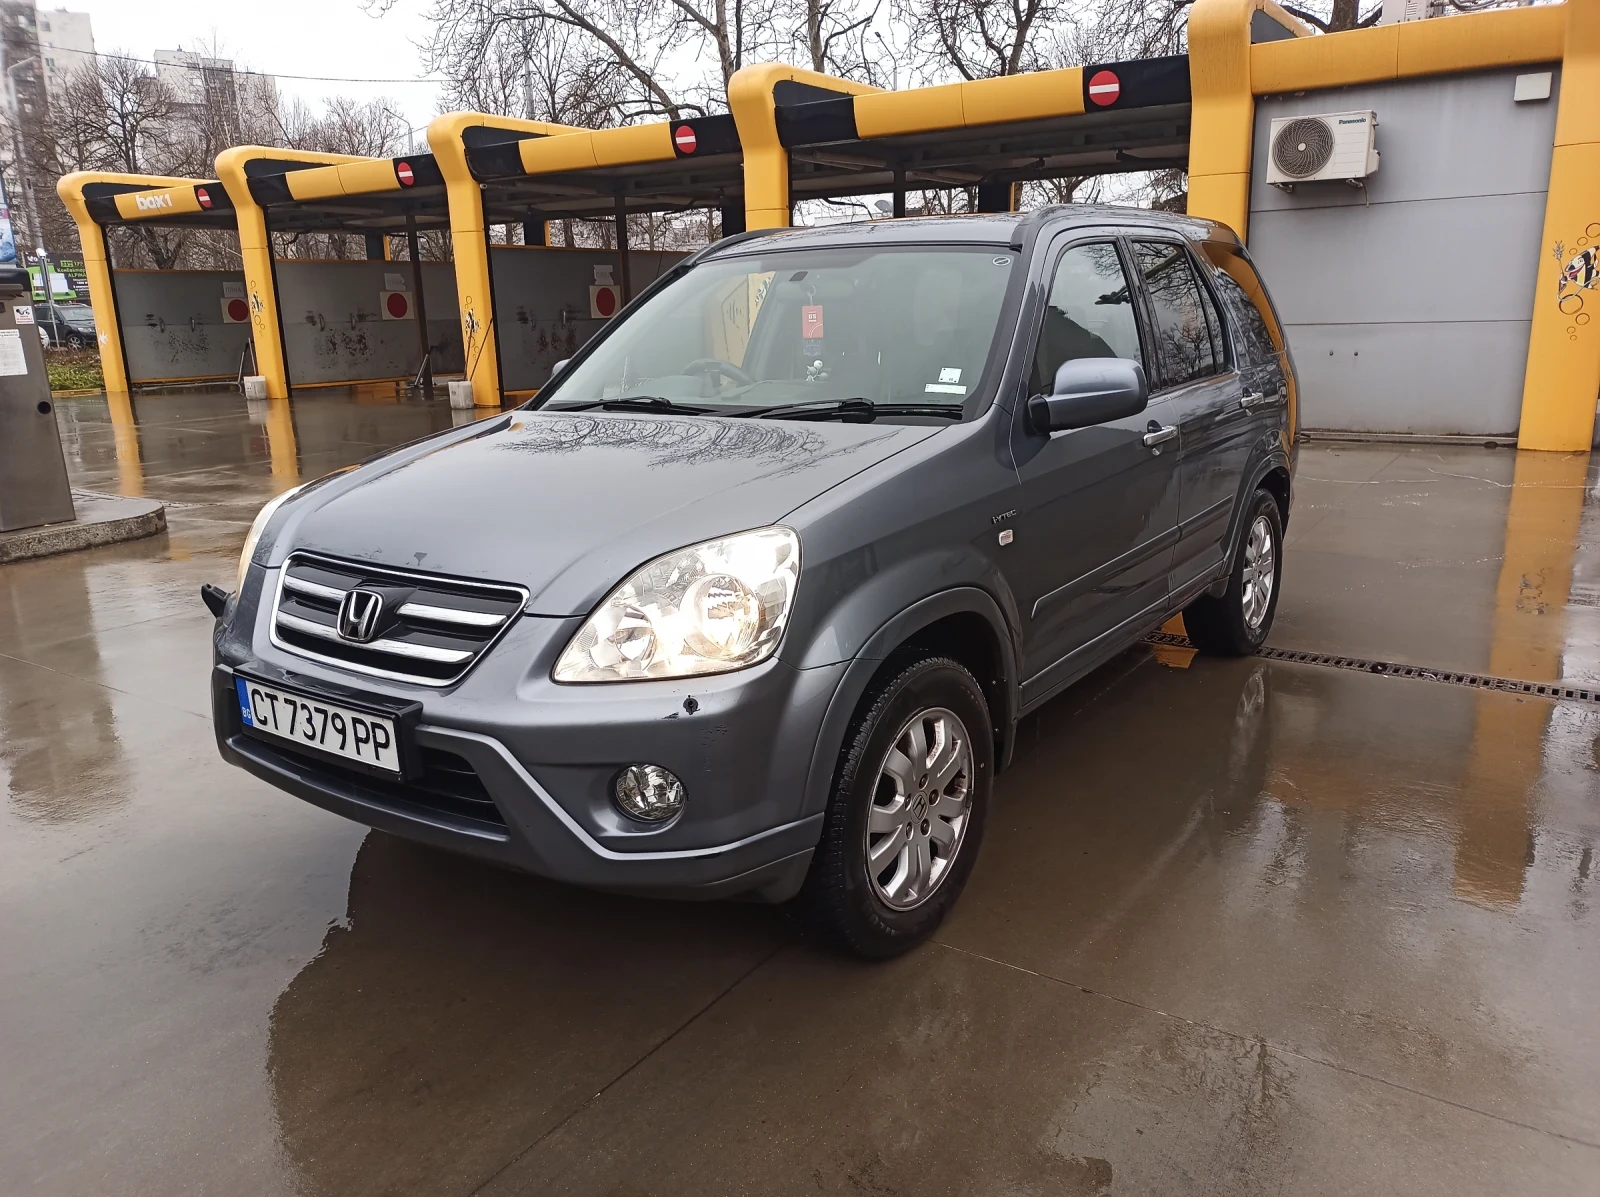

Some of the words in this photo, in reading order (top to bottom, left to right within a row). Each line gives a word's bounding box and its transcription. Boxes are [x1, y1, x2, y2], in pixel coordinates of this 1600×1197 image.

[1339, 117, 1366, 125] Panasonic
[242, 706, 252, 719] BG
[283, 697, 347, 751] 7379
